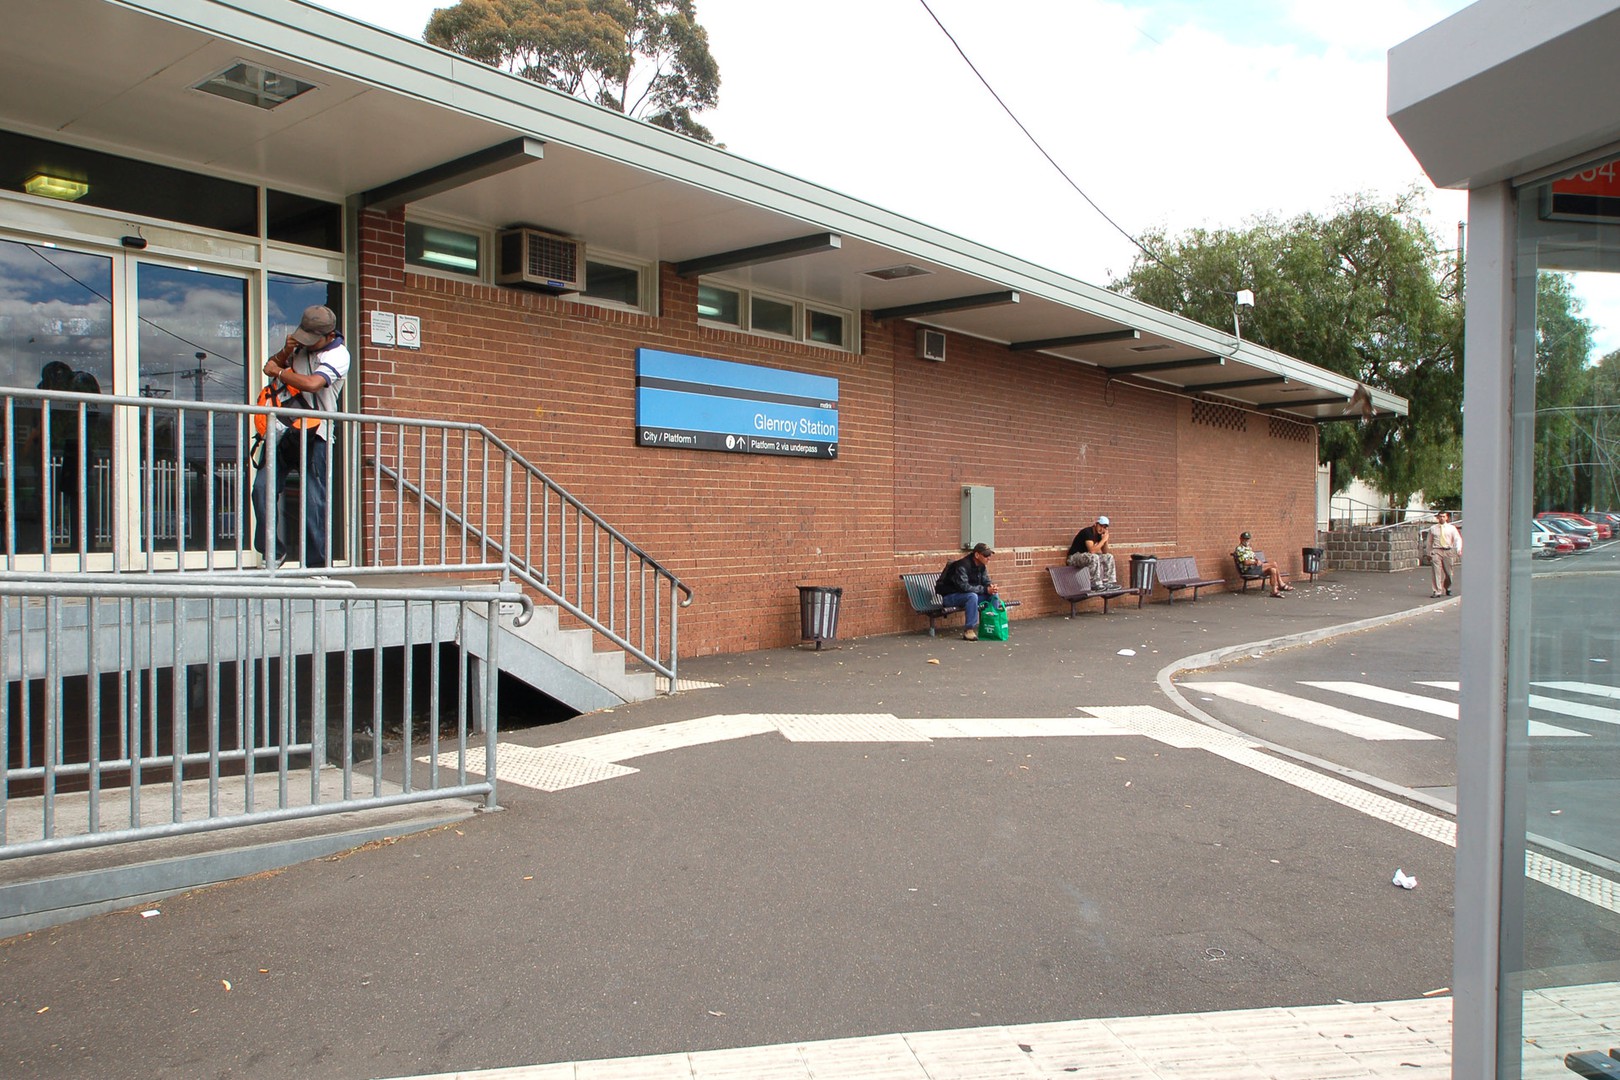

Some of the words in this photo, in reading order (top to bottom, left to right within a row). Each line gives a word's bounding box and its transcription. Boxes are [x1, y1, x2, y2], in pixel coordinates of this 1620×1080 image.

[754, 414, 798, 436] Glenroy
[800, 418, 836, 436] Station
[644, 431, 658, 442] City
[658, 432, 662, 442] /
[664, 432, 692, 444] Platform
[693, 435, 697, 444] 1
[751, 440, 775, 450] Platform
[776, 442, 780, 450] 2
[790, 444, 818, 454] underpass
